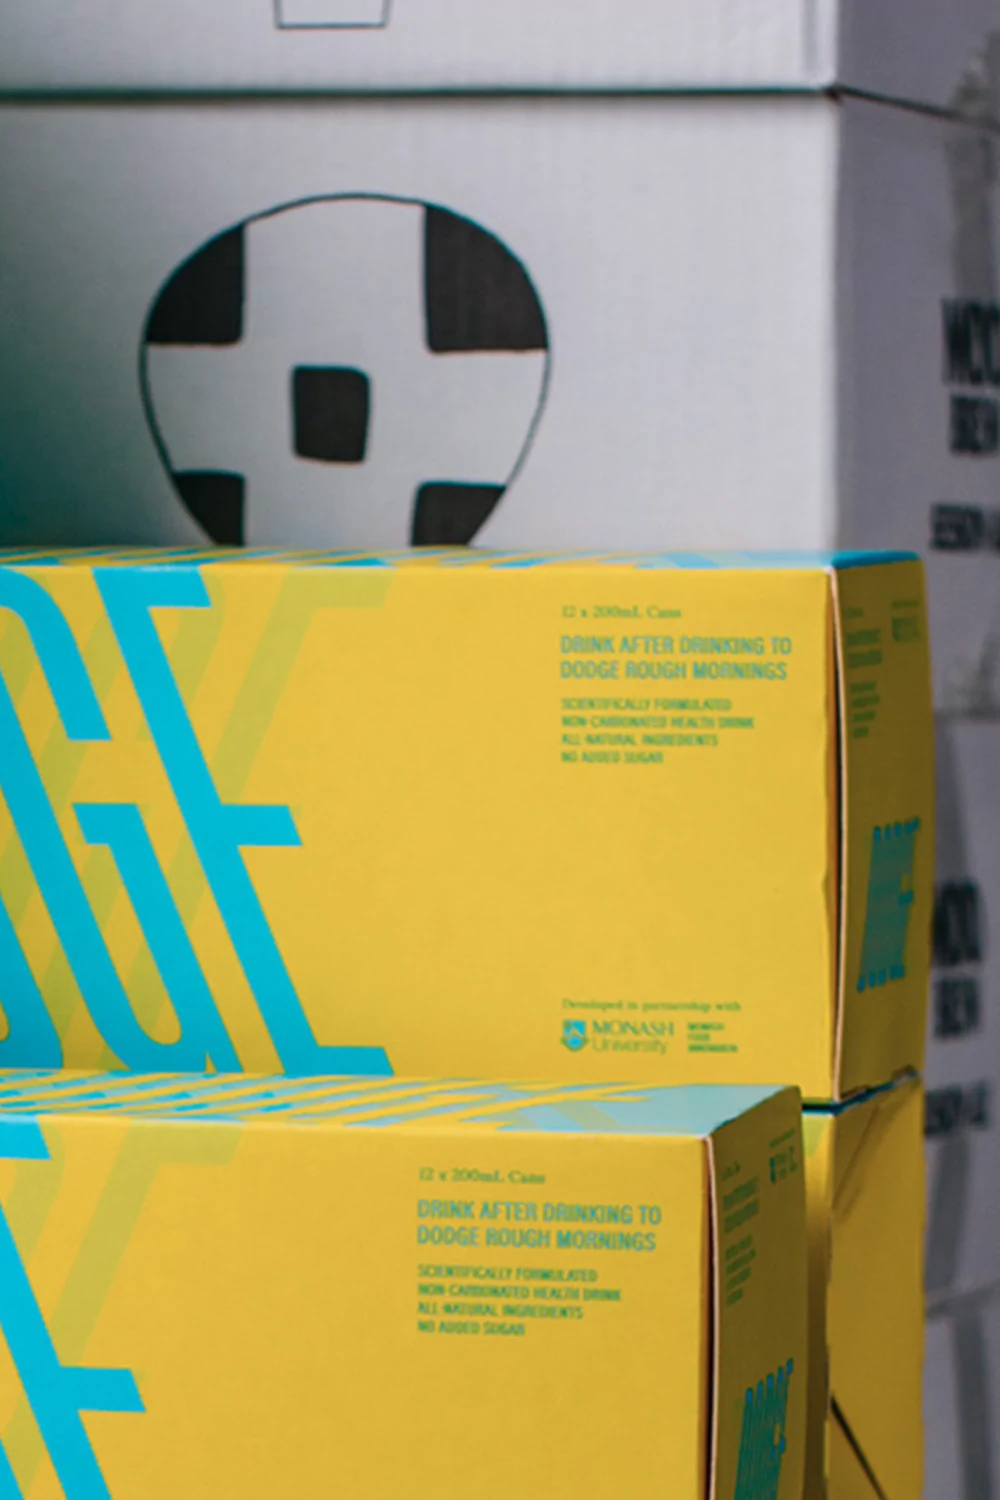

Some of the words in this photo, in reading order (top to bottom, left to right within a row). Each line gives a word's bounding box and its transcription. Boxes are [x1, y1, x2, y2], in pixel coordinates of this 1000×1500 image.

[561, 635, 615, 654] DRINK
[620, 635, 673, 654] AFTER
[679, 636, 764, 655] DRINKING
[771, 637, 792, 655] TO
[561, 661, 619, 679] DODGE
[626, 661, 686, 679] ROUGH
[693, 662, 787, 680] MORNINGS
[592, 1020, 674, 1036] MONASH
[592, 1038, 668, 1055] University
[417, 1199, 475, 1219] DRINK
[480, 1202, 537, 1220] AFTER
[543, 1203, 632, 1224] DRINKING
[638, 1205, 662, 1225] TO
[417, 1225, 479, 1246] DODGE
[486, 1228, 550, 1248] ROUGH
[557, 1231, 656, 1252] MORNINGS
